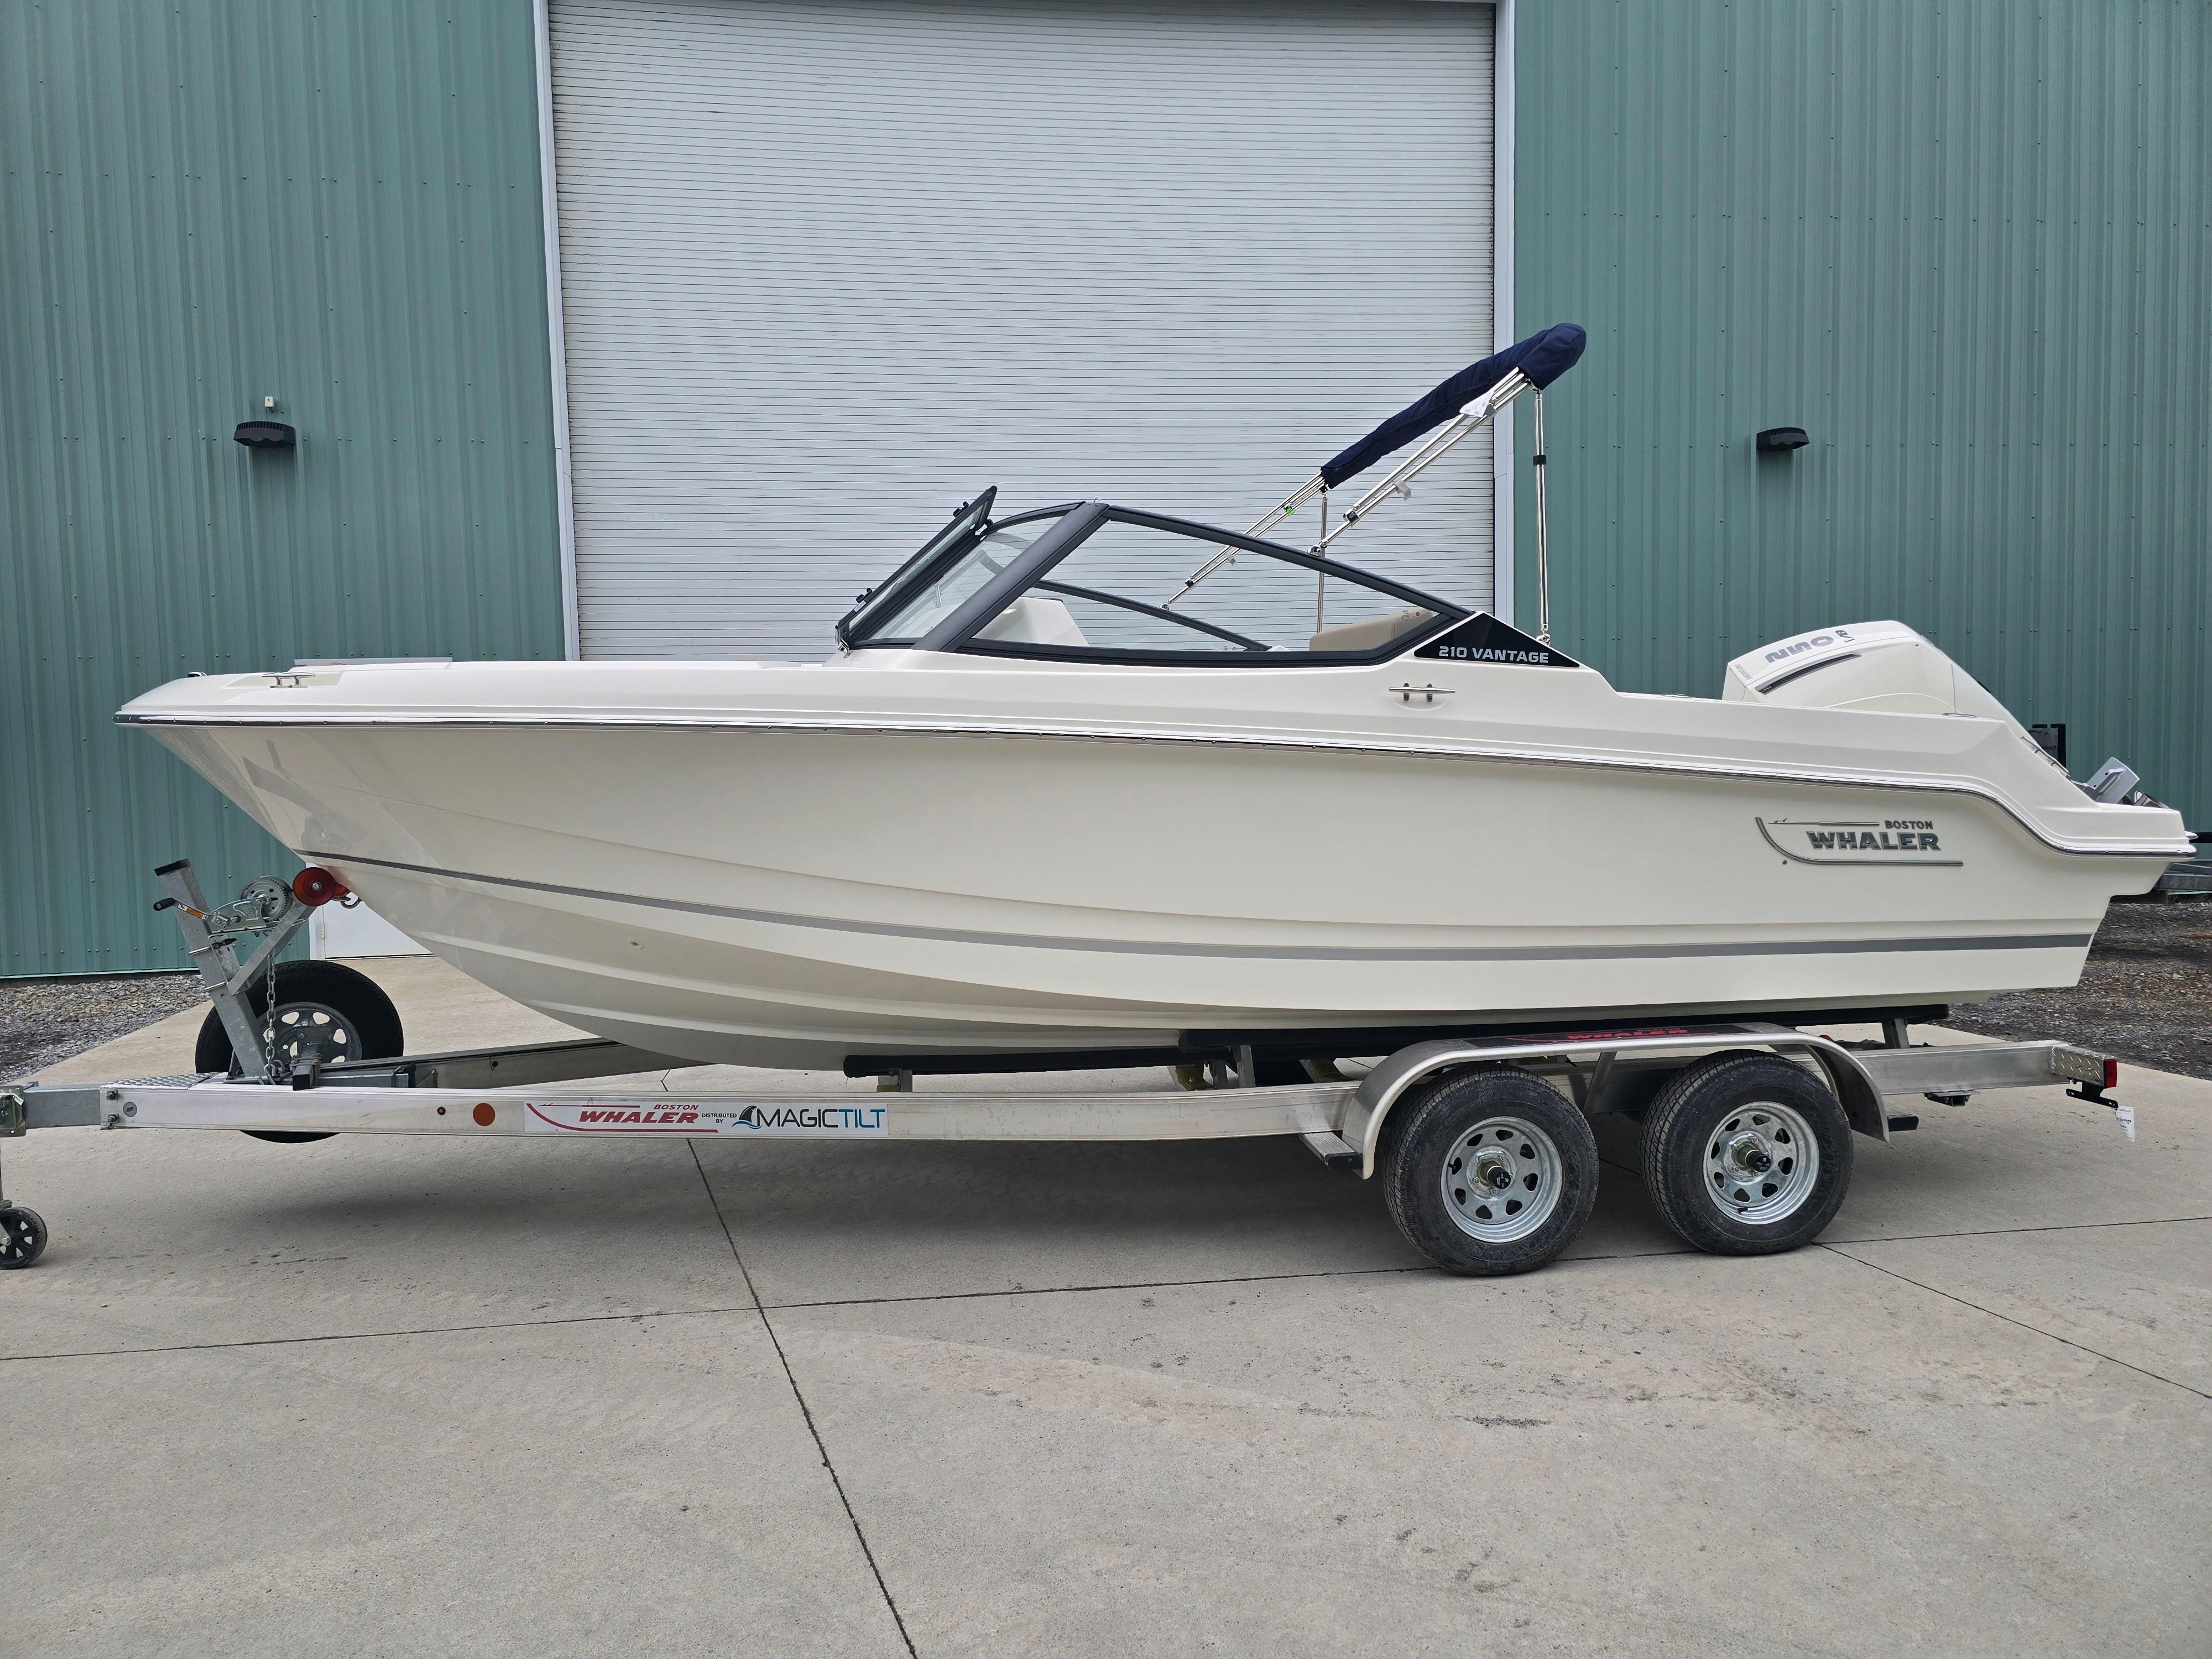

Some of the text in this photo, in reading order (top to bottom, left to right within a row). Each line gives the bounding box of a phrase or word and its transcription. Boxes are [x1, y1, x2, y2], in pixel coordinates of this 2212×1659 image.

[1439, 645, 1549, 664] 210 VANTAGE
[1765, 635, 1834, 664] 250
[1884, 820, 1933, 830] BOSTON
[1806, 831, 1942, 851] WHALER
[579, 1111, 699, 1124] WHALER
[757, 1108, 886, 1129] MAGICTILT
